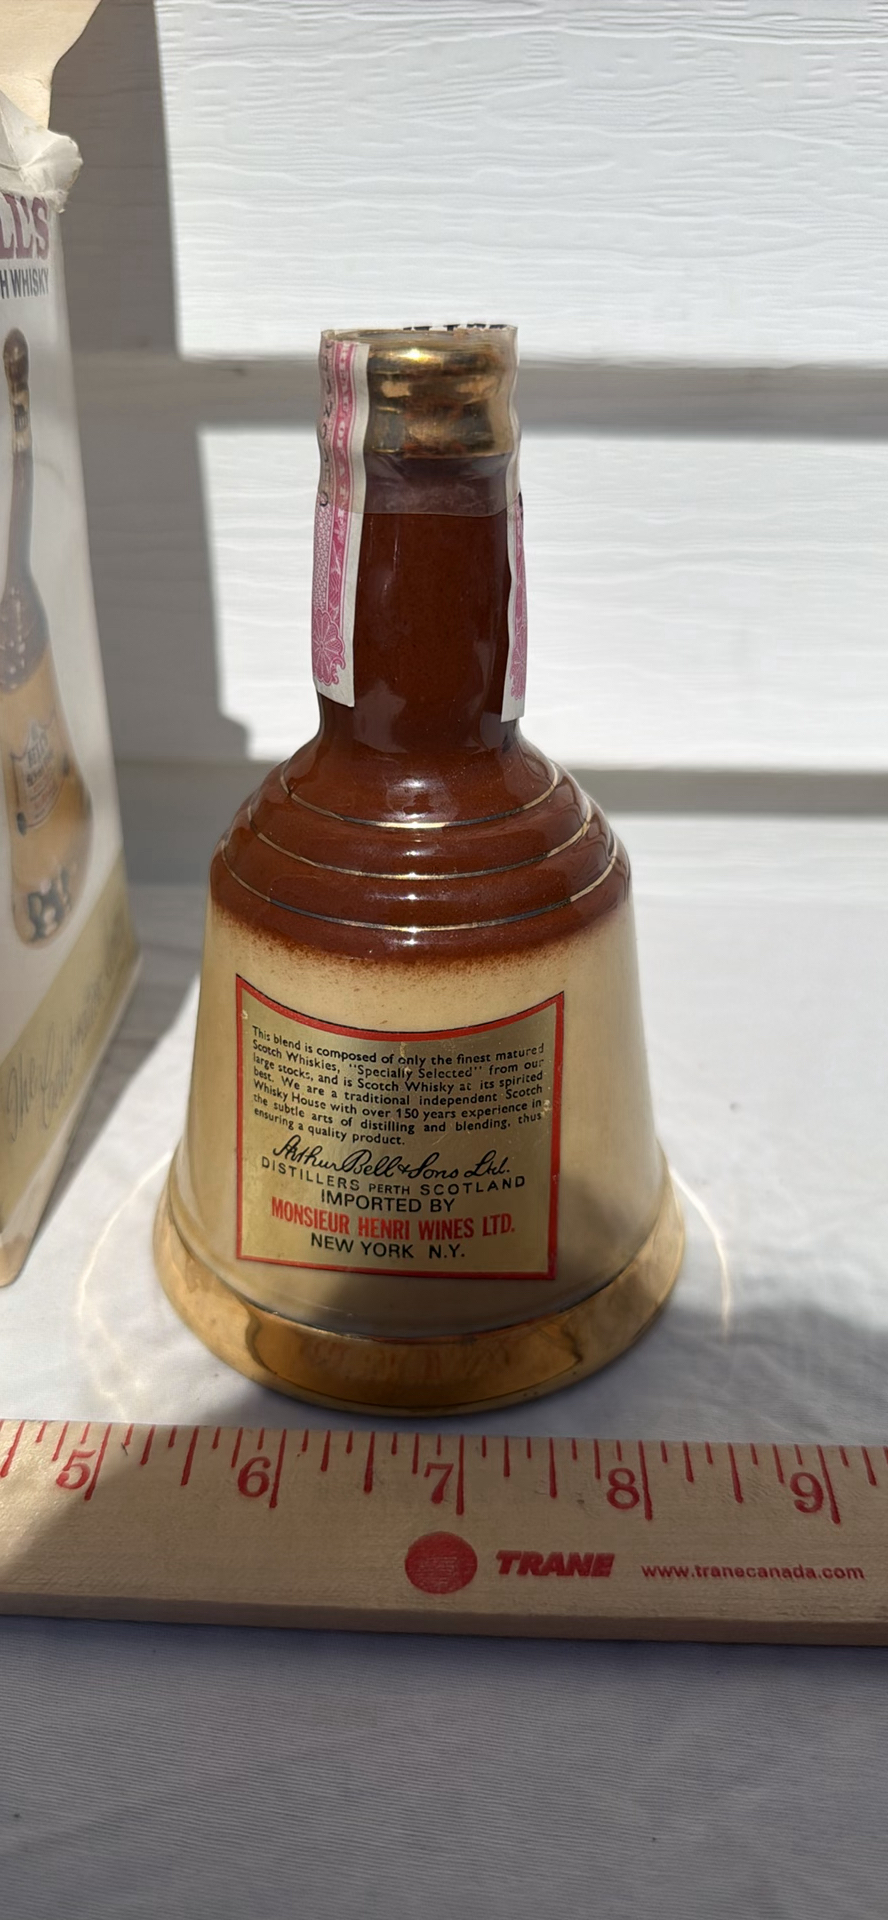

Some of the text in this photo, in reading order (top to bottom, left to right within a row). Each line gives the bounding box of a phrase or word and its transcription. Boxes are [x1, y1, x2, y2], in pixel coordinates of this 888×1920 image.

[10, 267, 49, 298] WHISKY
[252, 1025, 544, 1067] This blend is composed of only the finest matured
[253, 1039, 282, 1059] Scotch
[286, 1051, 341, 1074] Whiskies,
[489, 1064, 518, 1076] from
[524, 1059, 544, 1070] our
[253, 1052, 543, 1094] large stocks, and is Scotch Whisky at its spirited
[253, 1066, 542, 1107] best. We are a traditional independent Scotch
[253, 1078, 542, 1121] Whisky House with over 150 years experience in
[254, 1093, 268, 1106] the
[273, 1101, 305, 1118] subtle
[311, 1113, 333, 1124] arts
[340, 1117, 353, 1127] of
[361, 1120, 415, 1135] distilling
[424, 1122, 446, 1132] and
[518, 1112, 542, 1124] thus
[254, 1107, 405, 1145] ensuring a quality product.
[262, 1156, 525, 1196] DISTILLERS PERTH SCOTLAND
[341, 1149, 402, 1177] Bell
[408, 1152, 459, 1179] Sons
[463, 1149, 510, 1178] Ltd.
[272, 1196, 515, 1241] MONSIEUR HENRI WINES LTD.
[321, 1189, 455, 1213] IMPORTED BY
[311, 1232, 465, 1259] NEW YORK N.Y.
[55, 1449, 824, 1513] 5 6 7 8 9
[496, 1550, 865, 1581] TRANE www.tranecanada.com
